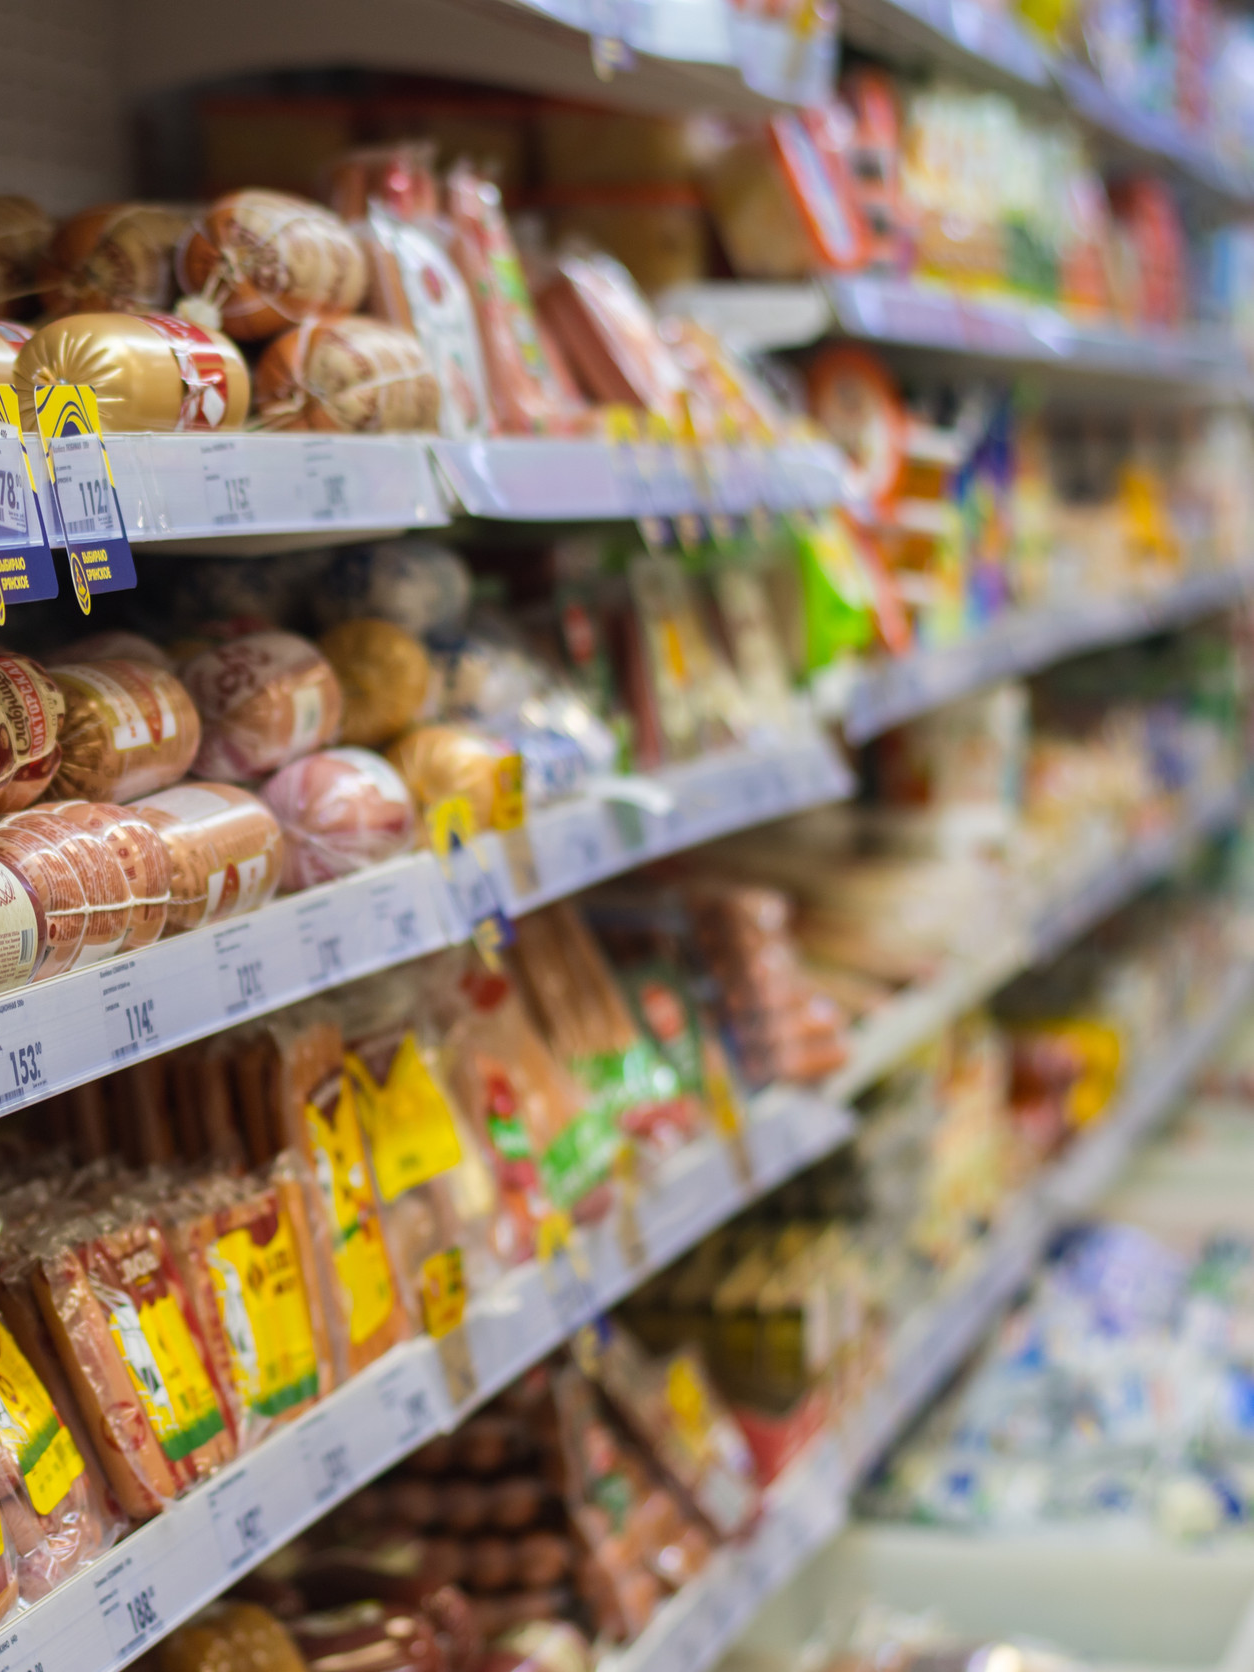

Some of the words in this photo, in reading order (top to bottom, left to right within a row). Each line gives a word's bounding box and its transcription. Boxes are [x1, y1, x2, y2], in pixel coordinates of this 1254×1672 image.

[81, 549, 108, 564] ВЫБИРАЮ
[86, 566, 112, 582] БРЯНСКОЕ
[0, 575, 30, 591] БРЯНСКОЕ
